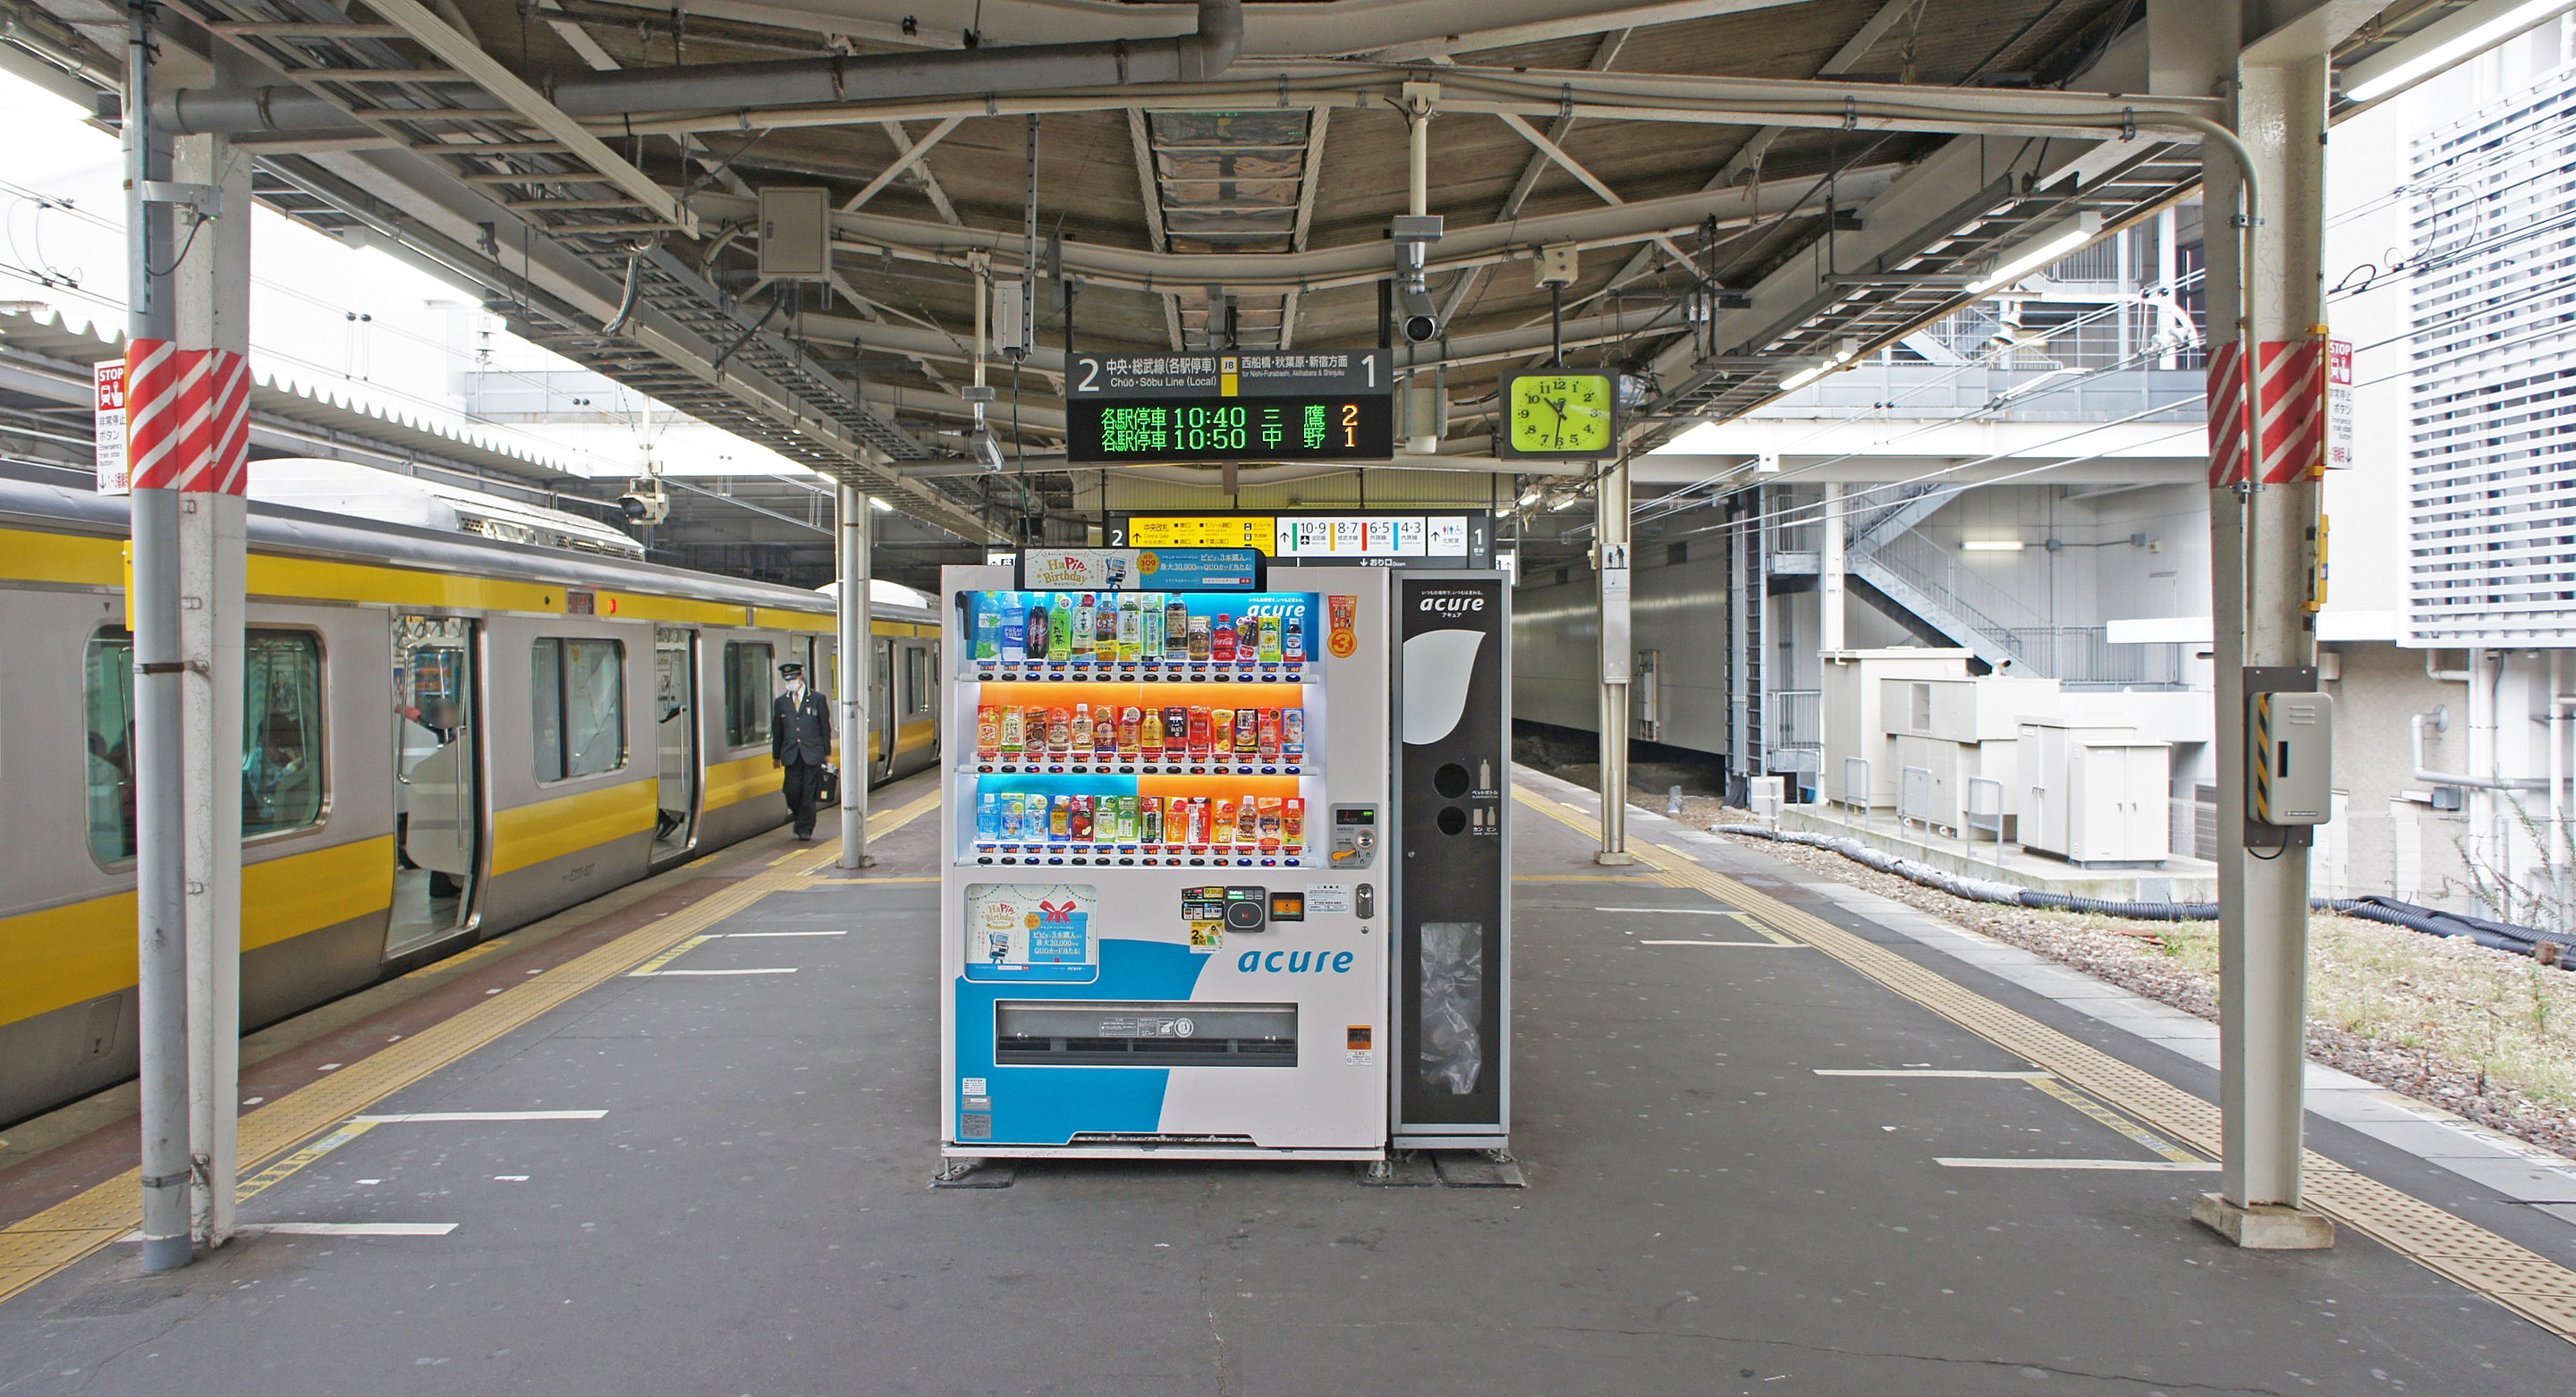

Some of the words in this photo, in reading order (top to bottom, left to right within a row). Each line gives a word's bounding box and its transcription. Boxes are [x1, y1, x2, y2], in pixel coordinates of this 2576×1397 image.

[2329, 343, 2351, 356] STOP
[1106, 357, 1216, 375] 中央・総武線(各駅停車)
[1241, 355, 1348, 368] 西船橋・秋葉原・新宿方面
[99, 368, 123, 382] STOP
[1078, 359, 1099, 392] 2
[1323, 369, 1344, 377] Shinjuku
[1361, 355, 1375, 387] 1
[1165, 377, 1183, 386] Line
[1186, 377, 1216, 387] (Local)
[1554, 381, 1566, 390] 12
[1539, 385, 1550, 394] 11
[1528, 394, 1539, 403] 10
[1583, 394, 1592, 402] 2
[1590, 409, 1598, 418] 3
[2334, 404, 2351, 414] ボタン
[1101, 408, 1166, 430] 各駅停車
[1174, 407, 1246, 428] 10:40
[1343, 404, 1359, 427] 2
[1521, 410, 1530, 419] 9
[99, 416, 126, 426] 非常停止
[1528, 425, 1537, 434] 8
[1583, 424, 1591, 433] 4
[99, 431, 119, 441] ボタン
[1101, 429, 1166, 452] 各駅停車
[1174, 428, 1246, 450] 10:50
[1344, 427, 1355, 447] 1
[1541, 435, 1549, 443] 7
[1570, 434, 1578, 443] 5
[1556, 437, 1563, 446] 6
[1144, 523, 1169, 532] 中央改札
[1112, 529, 1123, 546] 2
[1474, 529, 1482, 546] 1
[1369, 558, 1392, 567] おり口
[1042, 571, 1088, 585] Birthday
[1419, 597, 1485, 612] acure
[1247, 605, 1306, 617] acure
[985, 913, 1016, 923] Birthday
[1237, 951, 1354, 974] acure
